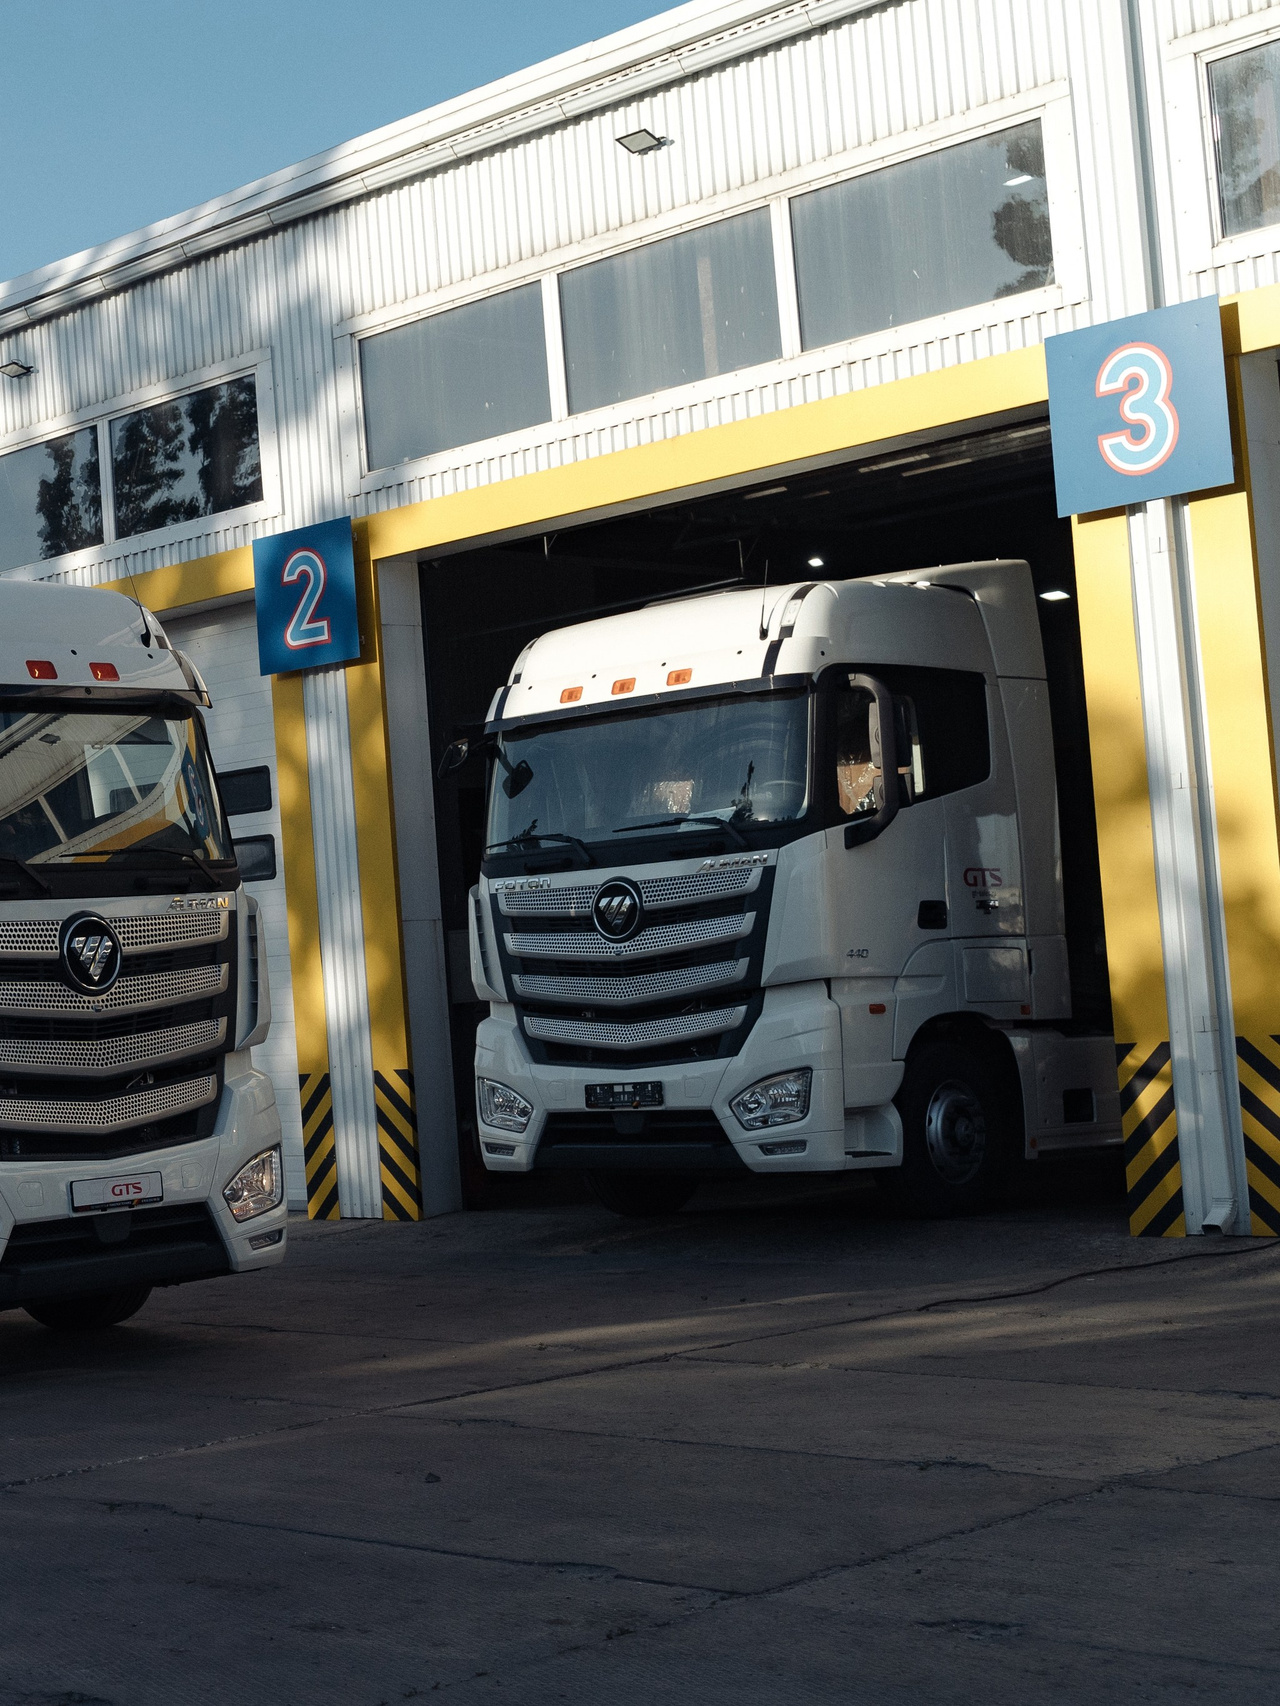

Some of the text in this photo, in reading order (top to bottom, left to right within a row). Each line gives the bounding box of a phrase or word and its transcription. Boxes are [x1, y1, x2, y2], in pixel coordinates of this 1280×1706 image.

[1095, 341, 1180, 476] 3
[280, 546, 332, 650] 2
[494, 877, 551, 893] FOTON
[963, 867, 1003, 888] GTS
[111, 1181, 143, 1197] GTS
